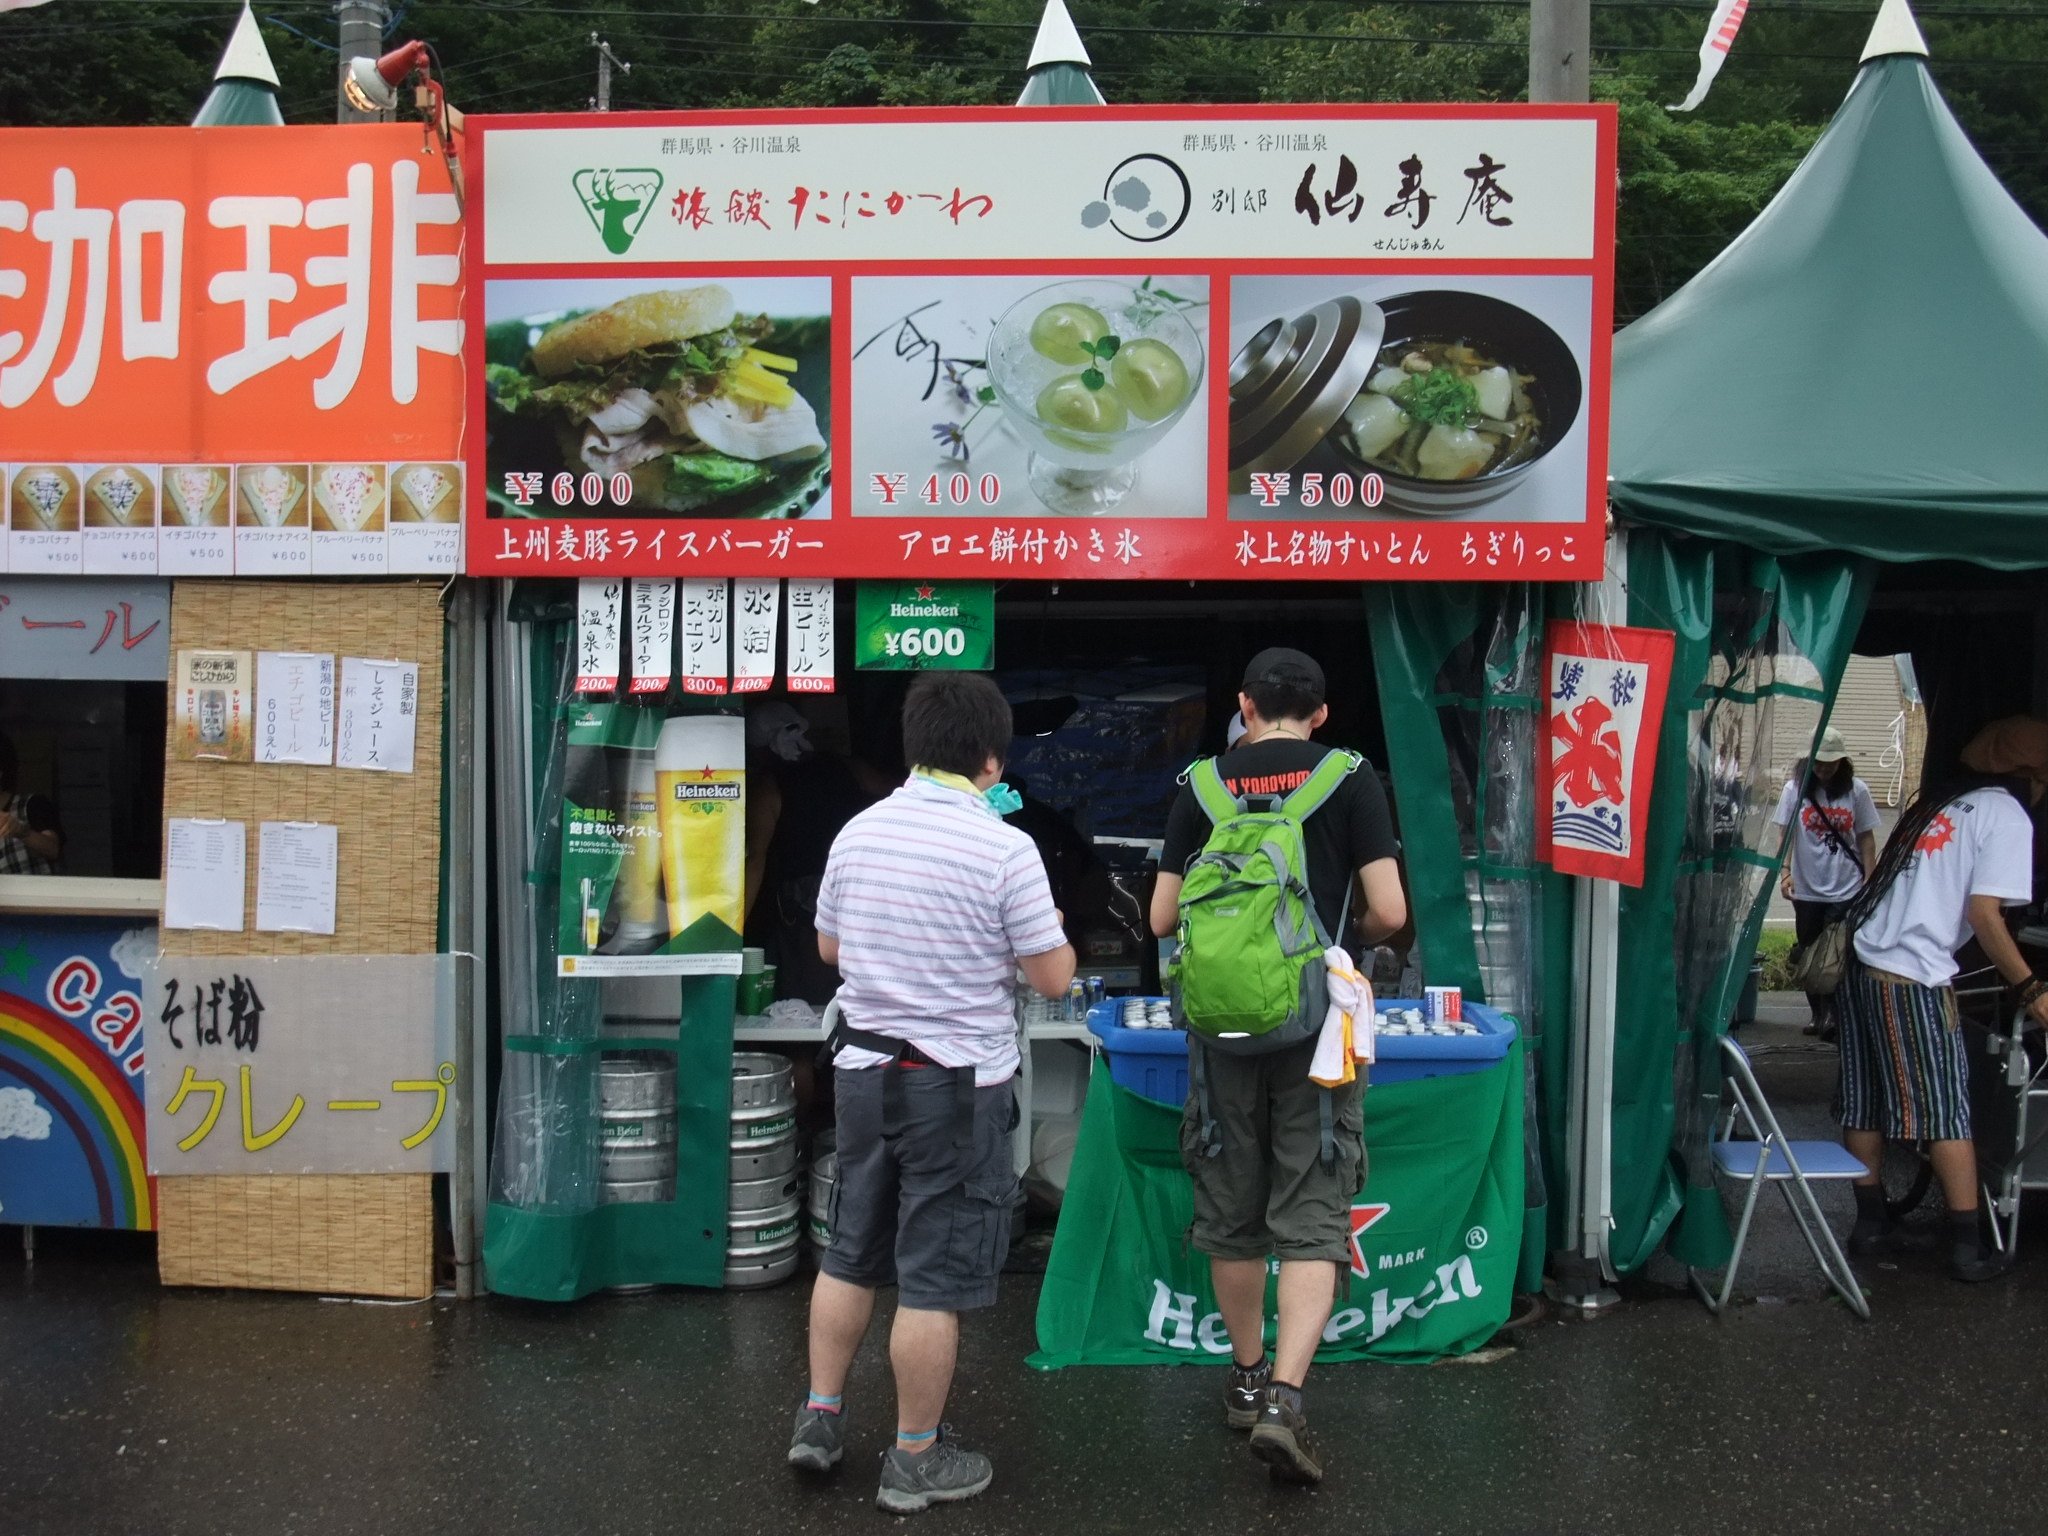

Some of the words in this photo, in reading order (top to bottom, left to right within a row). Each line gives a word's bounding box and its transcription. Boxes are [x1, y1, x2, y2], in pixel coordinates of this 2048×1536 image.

[660, 136, 801, 155] 群馬県・谷川温泉
[1182, 133, 1329, 153] 群馬県・谷川温泉
[1294, 153, 1515, 230] 仙寿庵
[1372, 237, 1446, 252] せんじゅあん
[0, 159, 466, 410] 珈琲
[504, 471, 634, 507] ¥600
[870, 472, 1002, 506] ¥400
[1250, 472, 1385, 507] ¥500
[18, 535, 72, 545] チョコバナナ
[83, 531, 156, 541] チョコバナナアイス
[165, 531, 218, 541] イチゴバナナ
[236, 532, 309, 542] イチゴバナナアイス
[316, 535, 384, 545] ブルーベリーバナナ
[433, 540, 457, 549] アイス
[494, 523, 825, 562] 上州麦豚ライスバーガー
[897, 527, 1144, 565] アロエ餅付かき氷
[1234, 529, 1432, 567] 水上名物すいとん
[1460, 530, 1577, 567] ちぎりっこ
[48, 552, 79, 562] ¥500
[190, 548, 224, 559] ¥500
[0, 594, 161, 655] ール
[706, 583, 724, 644] ポカリ
[743, 584, 772, 654] 氷結
[816, 584, 831, 658] ハイネケン
[890, 603, 959, 617] Heineken
[581, 609, 603, 674] 温泉水
[636, 583, 653, 674] ミネラルウォーター
[686, 600, 704, 675] スエット
[791, 586, 814, 673] 生ビール
[884, 627, 966, 657] ¥600
[192, 671, 235, 683] こしひかり
[400, 672, 415, 716] 自家製
[687, 678, 723, 692] 300円
[792, 679, 830, 691] 600円
[286, 665, 305, 754] エチゴビール
[318, 659, 334, 749] 新潟の地ビール
[366, 670, 385, 763] しそジュース
[264, 698, 277, 761] 600えん
[677, 784, 739, 798] Heineken
[569, 822, 663, 838] 飽きないテイスト。
[570, 808, 616, 822] 不思議と
[161, 973, 265, 1053] そば粉
[165, 1061, 457, 1153] クレープ
[616, 1125, 642, 1136] Beer
[750, 1121, 787, 1137] Heineken
[1377, 1246, 1427, 1271] MARK
[1142, 1253, 1484, 1356] Heeken
